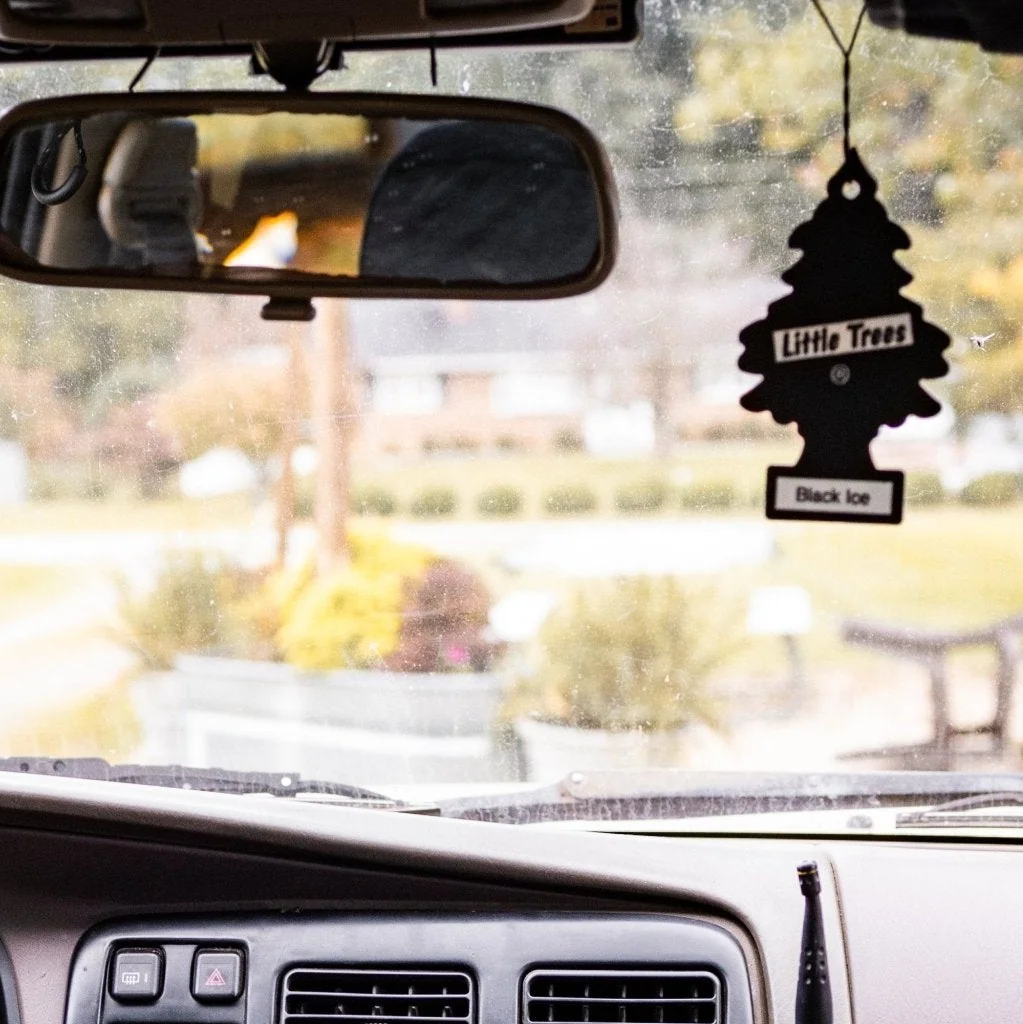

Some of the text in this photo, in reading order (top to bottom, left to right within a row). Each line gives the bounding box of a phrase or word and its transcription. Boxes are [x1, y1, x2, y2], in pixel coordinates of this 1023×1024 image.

[782, 322, 907, 358] Little Trees
[796, 486, 870, 506] Black Ice
